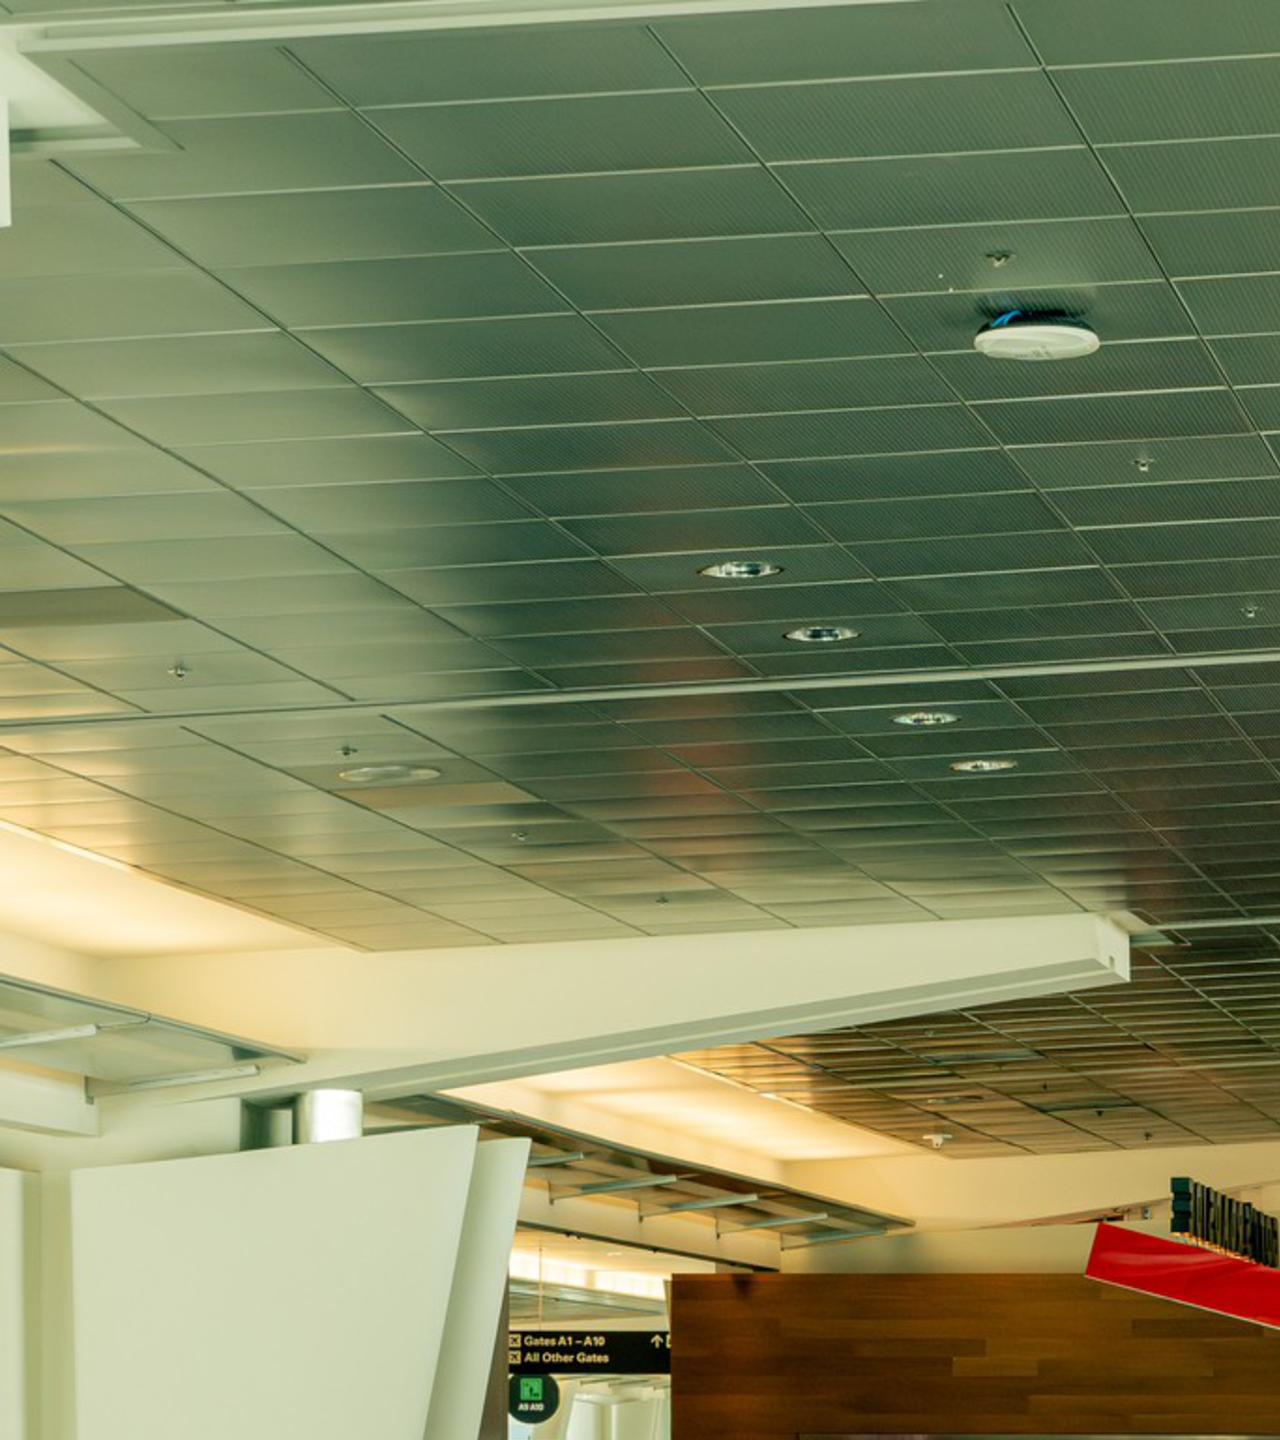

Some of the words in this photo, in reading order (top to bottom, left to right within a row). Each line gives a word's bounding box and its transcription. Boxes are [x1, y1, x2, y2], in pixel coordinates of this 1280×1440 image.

[524, 1336, 556, 1347] Gates
[558, 1336, 573, 1346] A1
[583, 1336, 606, 1346] A10
[524, 1352, 540, 1362] All
[542, 1351, 575, 1363] Other
[576, 1351, 610, 1363] Gates
